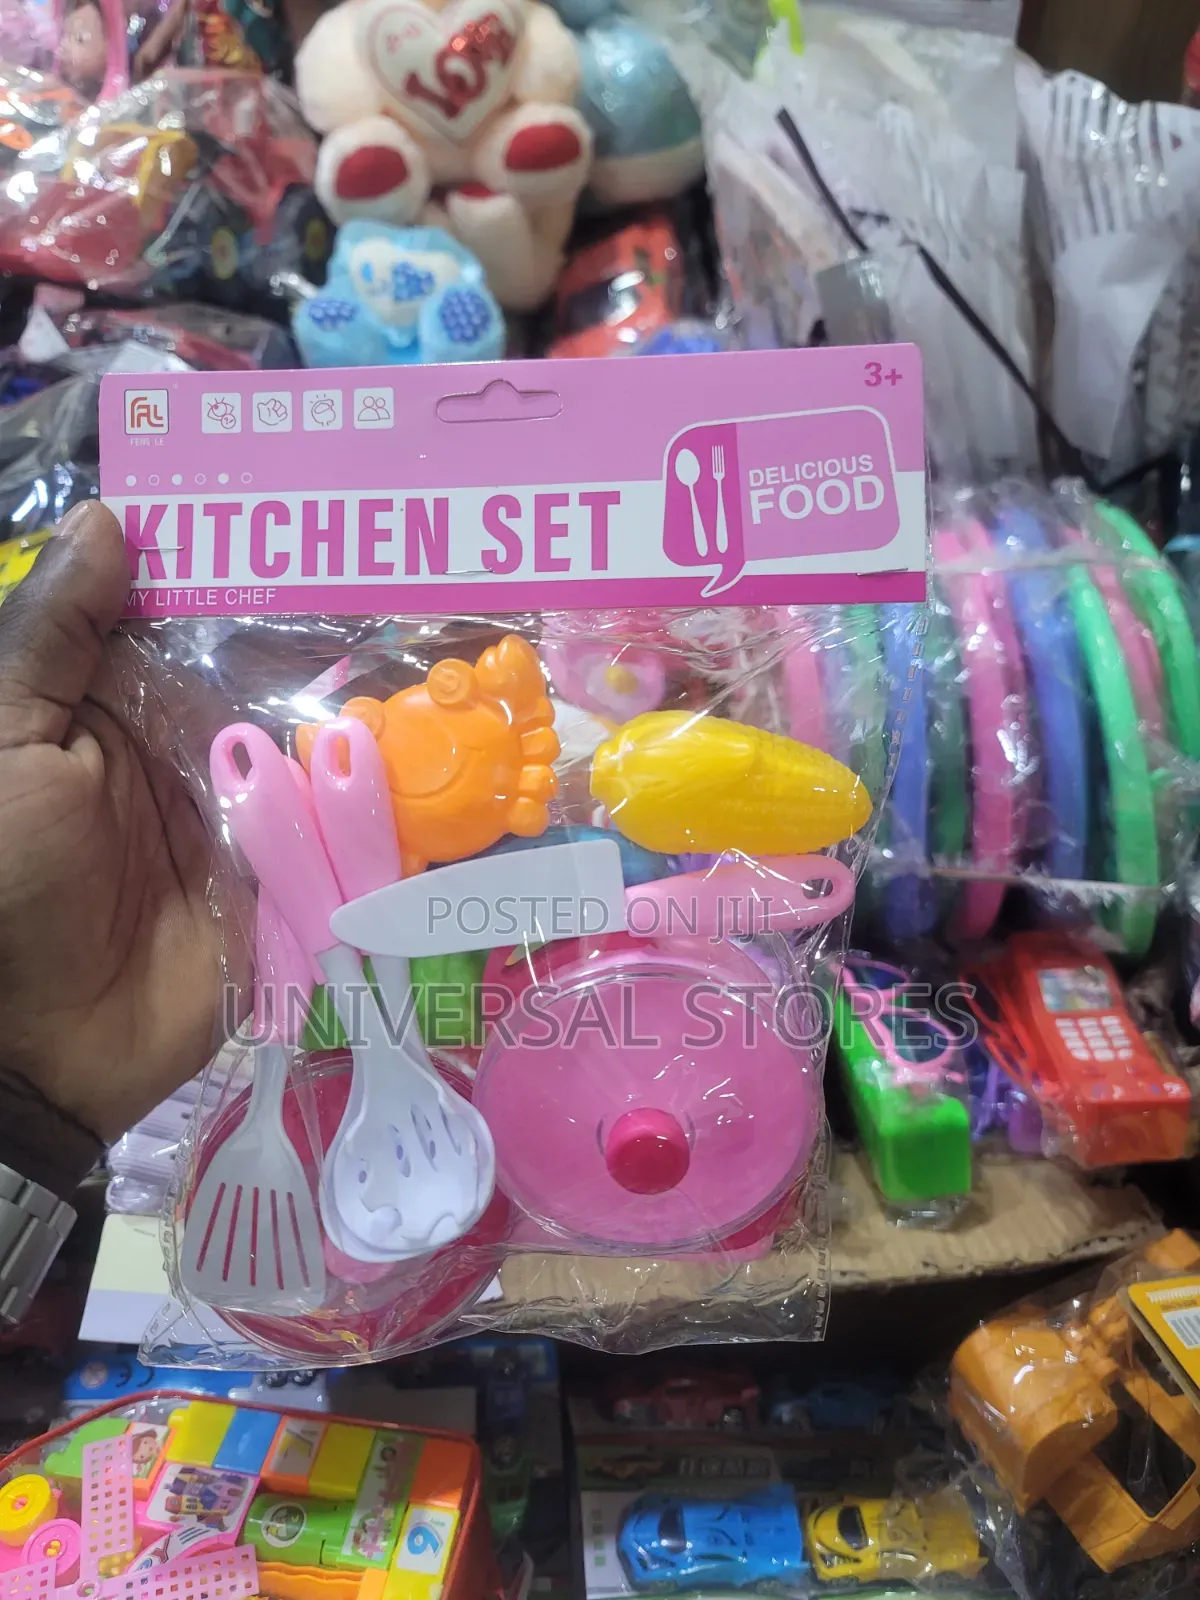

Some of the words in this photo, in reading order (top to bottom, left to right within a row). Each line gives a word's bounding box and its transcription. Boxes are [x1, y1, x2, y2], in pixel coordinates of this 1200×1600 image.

[864, 361, 903, 387] 3+
[130, 438, 150, 447] FENG
[154, 438, 165, 446] LE
[749, 454, 874, 487] DELICIOUS
[750, 475, 885, 525] FOOD
[125, 496, 450, 580] KITCHEN
[480, 490, 621, 575] SET
[155, 589, 218, 607] LITTLE
[225, 588, 276, 605] CHEF
